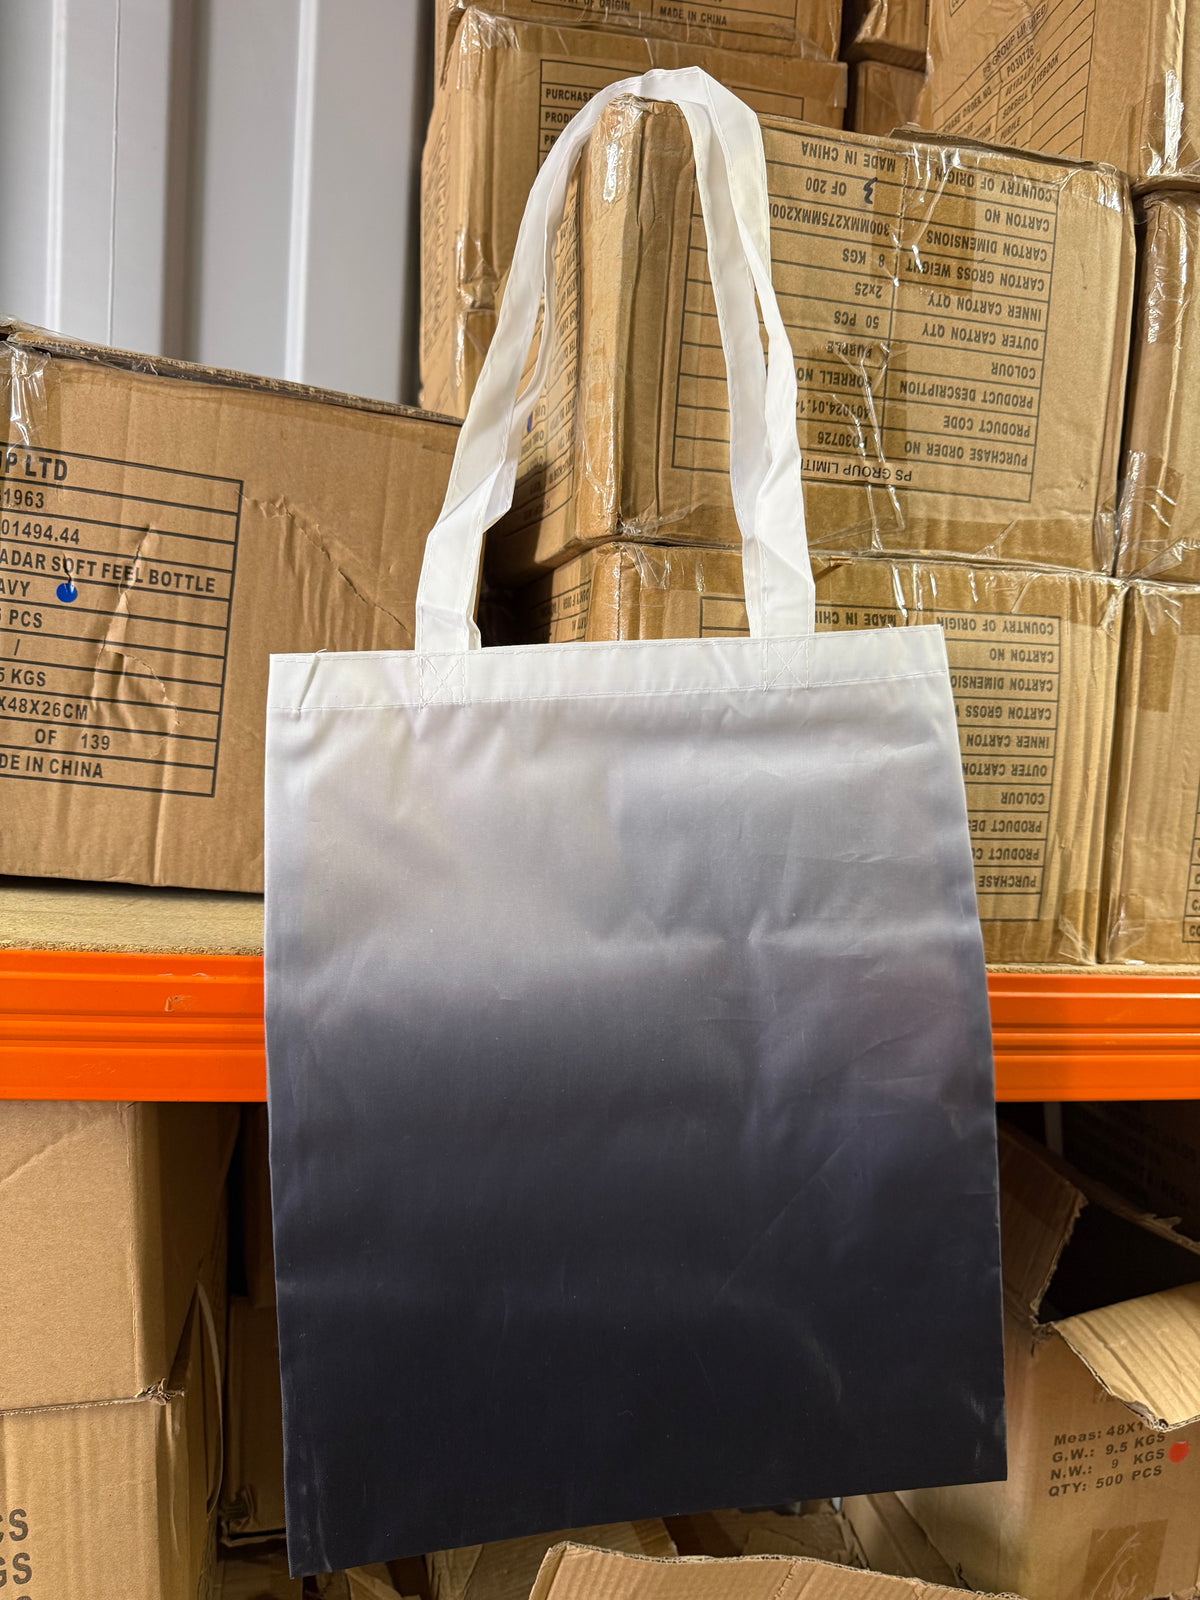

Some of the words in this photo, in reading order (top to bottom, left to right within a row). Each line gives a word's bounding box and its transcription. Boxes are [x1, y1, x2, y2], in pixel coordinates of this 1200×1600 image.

[660, 6, 683, 19] MADE
[688, 11, 696, 20] IN
[701, 13, 727, 25] CHINA
[801, 141, 839, 162] CHINA
[845, 150, 858, 165] IN
[864, 153, 896, 172] MADE
[806, 178, 827, 194] 200
[934, 167, 974, 188] ORIGIN
[980, 178, 994, 192] OF
[830, 181, 847, 197] OF
[1000, 180, 1052, 202] COUNTRY
[984, 208, 1000, 223] NO
[1005, 212, 1050, 232] CARTON
[926, 230, 998, 252] DIMENSIONS
[842, 248, 866, 265] KGS
[878, 254, 885, 265] 8
[1003, 242, 1047, 262] CARTON
[906, 258, 951, 278] WEIGHT
[956, 265, 994, 284] GROSS
[854, 282, 882, 299] 2x25
[1000, 273, 1044, 292] CARTON
[928, 295, 951, 309] QTY
[956, 298, 1002, 316] CARTON
[833, 310, 857, 327] PCS
[866, 315, 879, 329] 50
[1006, 305, 1042, 322] INNER
[921, 323, 944, 338] QTY
[951, 328, 996, 346] CARTON
[826, 341, 872, 359] PURPLE
[1001, 334, 1039, 351] OUTER
[820, 370, 872, 388] SORRELL
[990, 362, 1036, 380] COLOUR
[900, 381, 976, 402] DESCRIPTION
[982, 391, 1033, 409] PRODUCT
[943, 416, 973, 431] CODE
[979, 420, 1030, 438] PRODUCT
[904, 441, 921, 455] NO
[926, 443, 964, 460] ORDER
[800, 458, 839, 474] LIMIT
[970, 448, 1028, 467] PURCHASE
[26, 455, 67, 481] LTD
[843, 463, 891, 480] GROUP
[896, 469, 912, 481] PS
[0, 488, 44, 508] 1963
[1, 519, 80, 544] 01494.44
[51, 556, 98, 576] SOFT
[102, 563, 143, 583] FEEL
[149, 570, 215, 593] BOTTLE
[10, 609, 42, 628] PCS
[846, 613, 857, 625] IN
[863, 613, 896, 627] MADE
[936, 617, 976, 630] ORIGIN
[982, 620, 996, 633] OF
[1003, 620, 1054, 636] COUNTRY
[989, 649, 1005, 661] NO
[1010, 649, 1054, 664] CARTON
[11, 668, 46, 687] KGS
[1009, 677, 1053, 692] CARTON
[965, 705, 1002, 719] GROSS
[1008, 707, 1051, 720] CARTON
[35, 728, 57, 745] OF
[81, 733, 110, 750] 139
[966, 734, 1010, 747] CARTON
[1016, 736, 1049, 749] INNER
[26, 756, 46, 772] IN
[49, 760, 103, 778] CHINA
[962, 763, 1005, 776] CARTON
[1011, 764, 1047, 776] OUTER
[1001, 792, 1045, 805] COLOUR
[991, 820, 1042, 832] PRODUCT
[988, 848, 1039, 860] PRODUCT
[978, 875, 1036, 888] PURCHASE
[1054, 1431, 1102, 1446] Meas:
[1052, 1448, 1095, 1463] G.W.:
[1106, 1442, 1128, 1455] 9.5
[1135, 1432, 1166, 1448] KGS
[1051, 1465, 1092, 1480] N.W.:
[1112, 1459, 1119, 1468] 9
[1134, 1449, 1165, 1465] KGS
[1049, 1482, 1087, 1497] QTY:
[1096, 1474, 1123, 1489] 500
[1132, 1465, 1162, 1480] PCS
